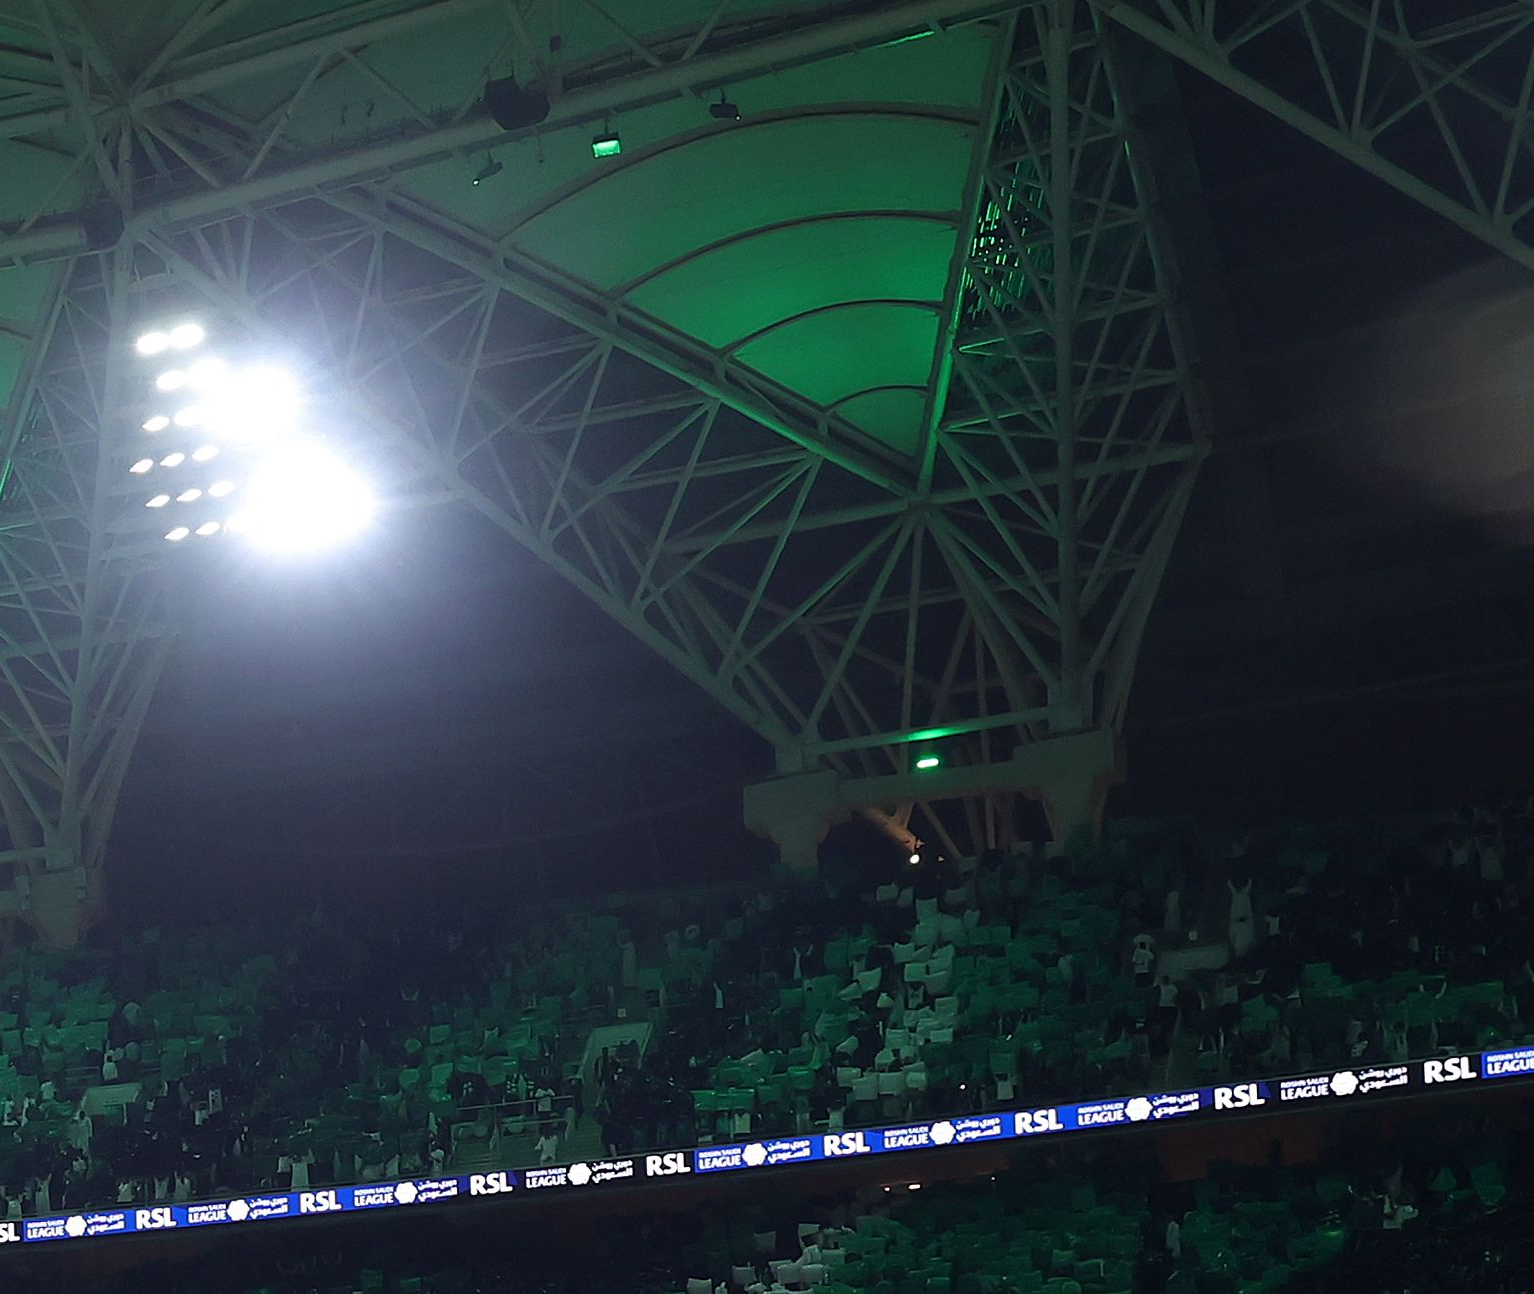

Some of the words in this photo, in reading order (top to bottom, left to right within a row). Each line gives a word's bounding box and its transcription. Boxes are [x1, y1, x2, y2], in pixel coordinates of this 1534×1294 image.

[1423, 1056, 1477, 1083] RSL
[1214, 1082, 1265, 1109] RSL
[1280, 1083, 1331, 1100] LEAGUE
[1014, 1108, 1063, 1134] RSL
[1077, 1109, 1126, 1125] LEAGUE
[823, 1131, 871, 1156] RSL
[884, 1133, 930, 1148] LEAGUE
[646, 1151, 691, 1176] RSL
[698, 1154, 743, 1170] LEAGUE
[470, 1171, 513, 1195] RSL
[525, 1174, 568, 1189] LEAGUE
[299, 1189, 341, 1213] RSL
[354, 1192, 395, 1207] LEAGUE
[135, 1206, 177, 1229] RSL
[188, 1209, 228, 1223] LEAGUE
[27, 1225, 66, 1239] LEAGUE
